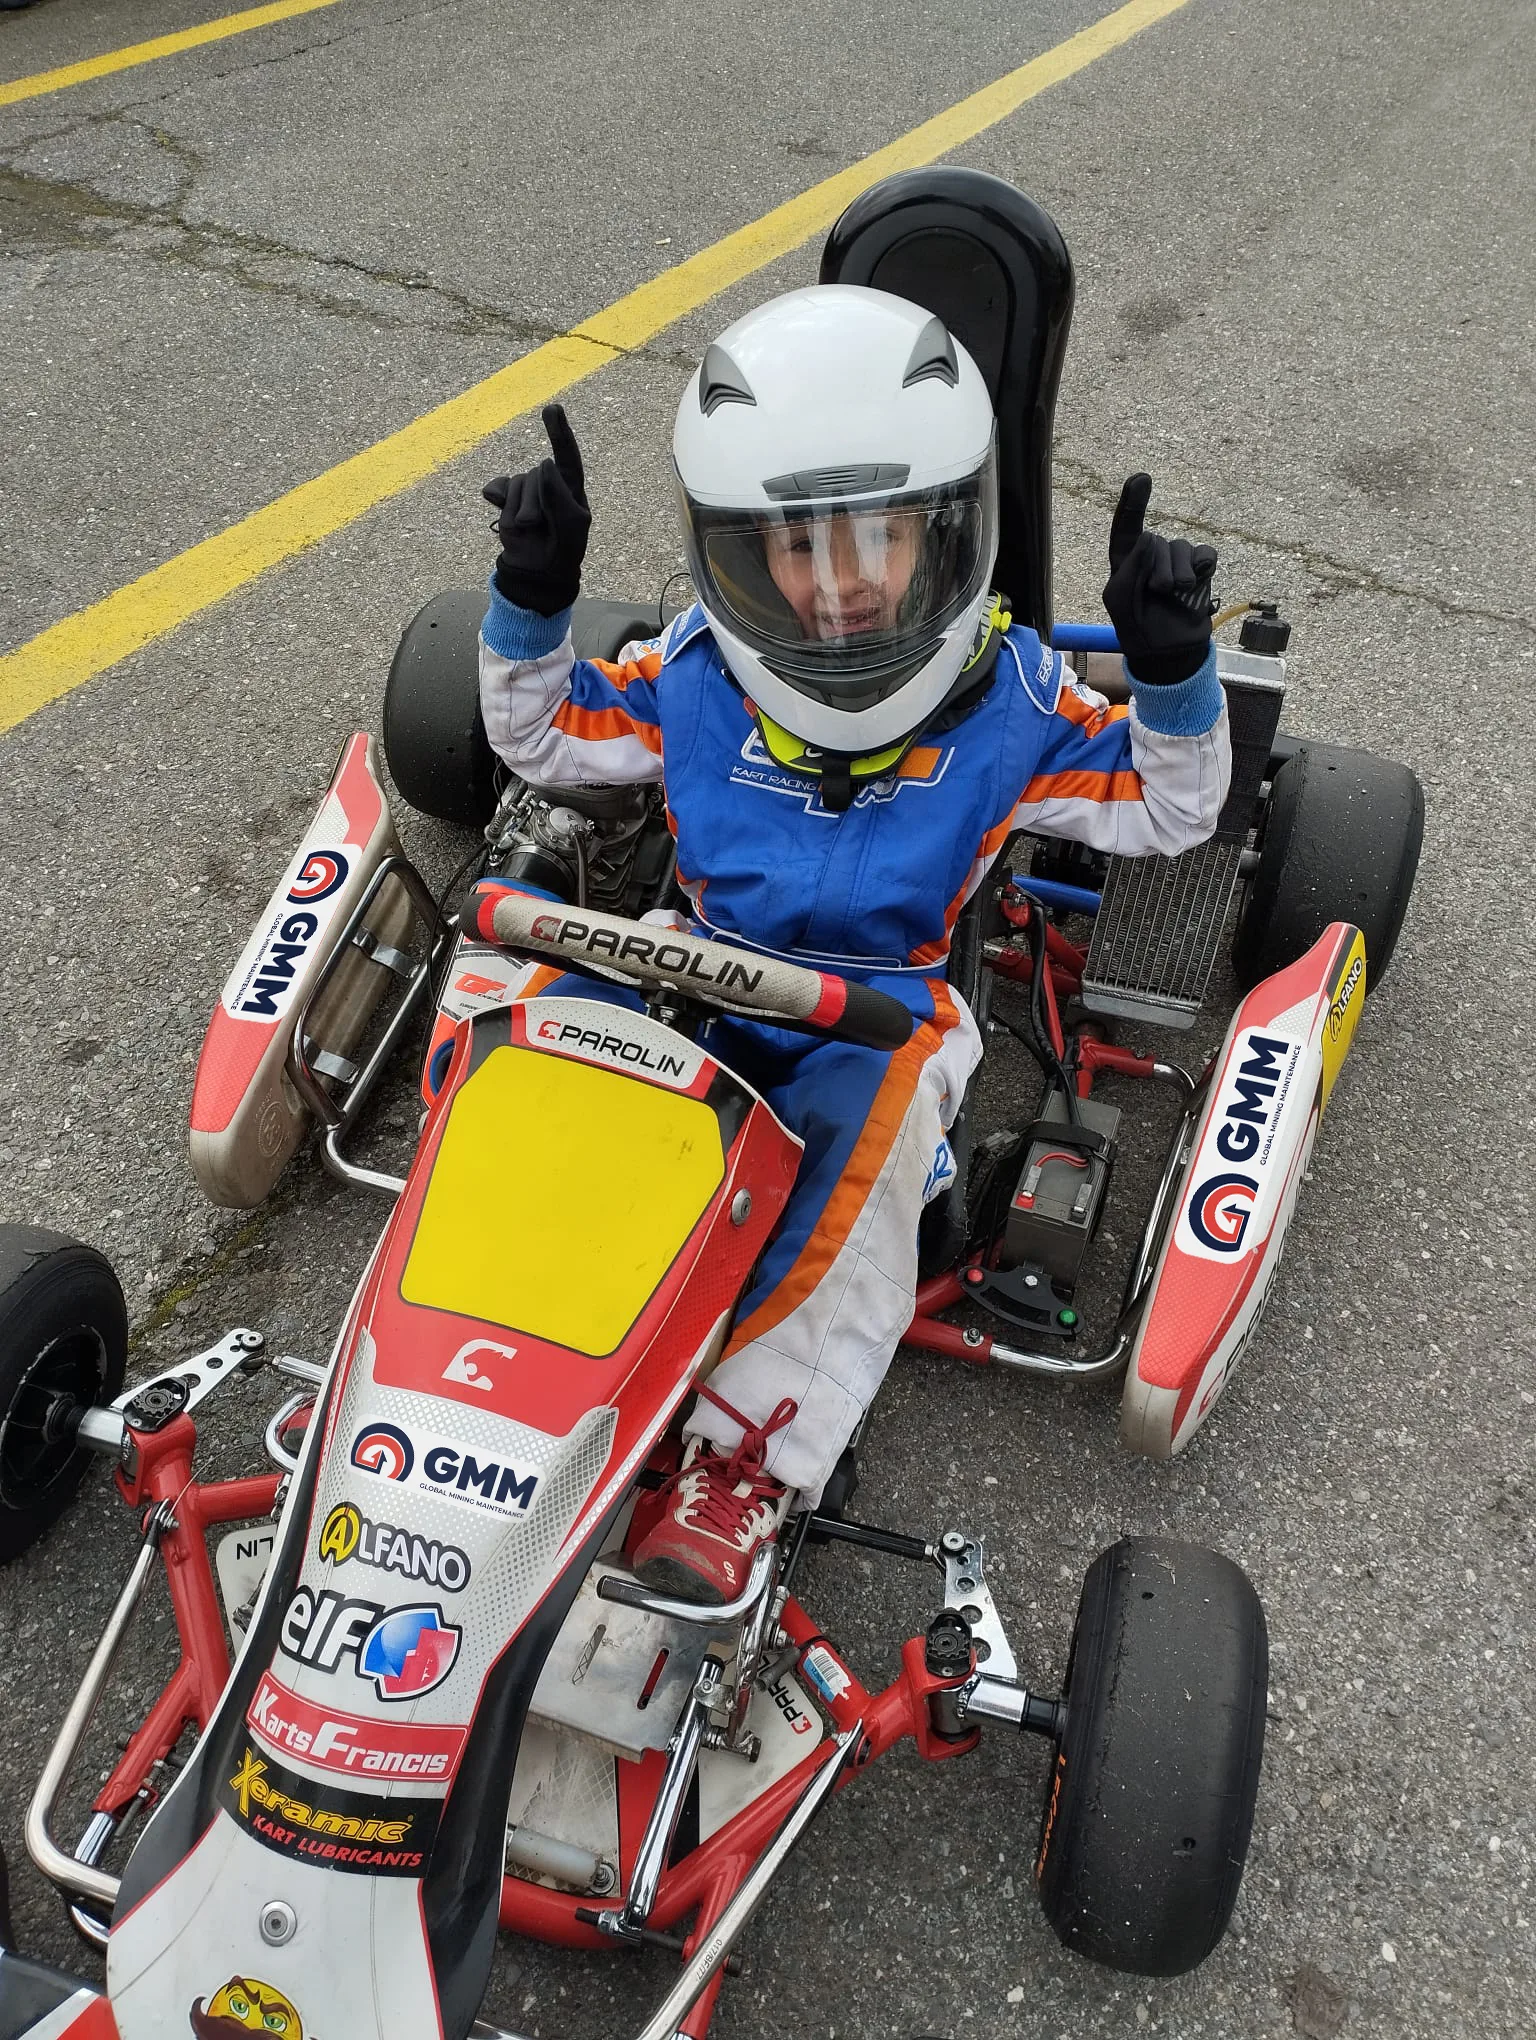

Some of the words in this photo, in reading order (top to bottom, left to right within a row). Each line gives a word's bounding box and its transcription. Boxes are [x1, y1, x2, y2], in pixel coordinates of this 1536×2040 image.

[733, 766, 767, 781] KART
[769, 775, 816, 791] RACING
[255, 938, 272, 961] MINING
[267, 913, 284, 937] GLOBAL
[240, 912, 318, 1016] GMM
[558, 920, 764, 993] PAROLIN
[230, 963, 258, 1010] MAINTENANCE
[559, 1027, 686, 1078] PAROLIN
[1217, 1035, 1290, 1163] GMM
[1259, 1134, 1275, 1166] GLOBAL
[1270, 1103, 1284, 1132] MINING
[1278, 1045, 1302, 1102] MAINTENANCE
[419, 1483, 447, 1497] GLOBAL
[448, 1492, 475, 1505] MINING
[476, 1501, 525, 1519] MAINTENANCE
[423, 1447, 539, 1510] GMM
[229, 1747, 412, 1843] Xeramic
[252, 1814, 297, 1845] KART
[297, 1837, 424, 1867] LUBRICANTS
